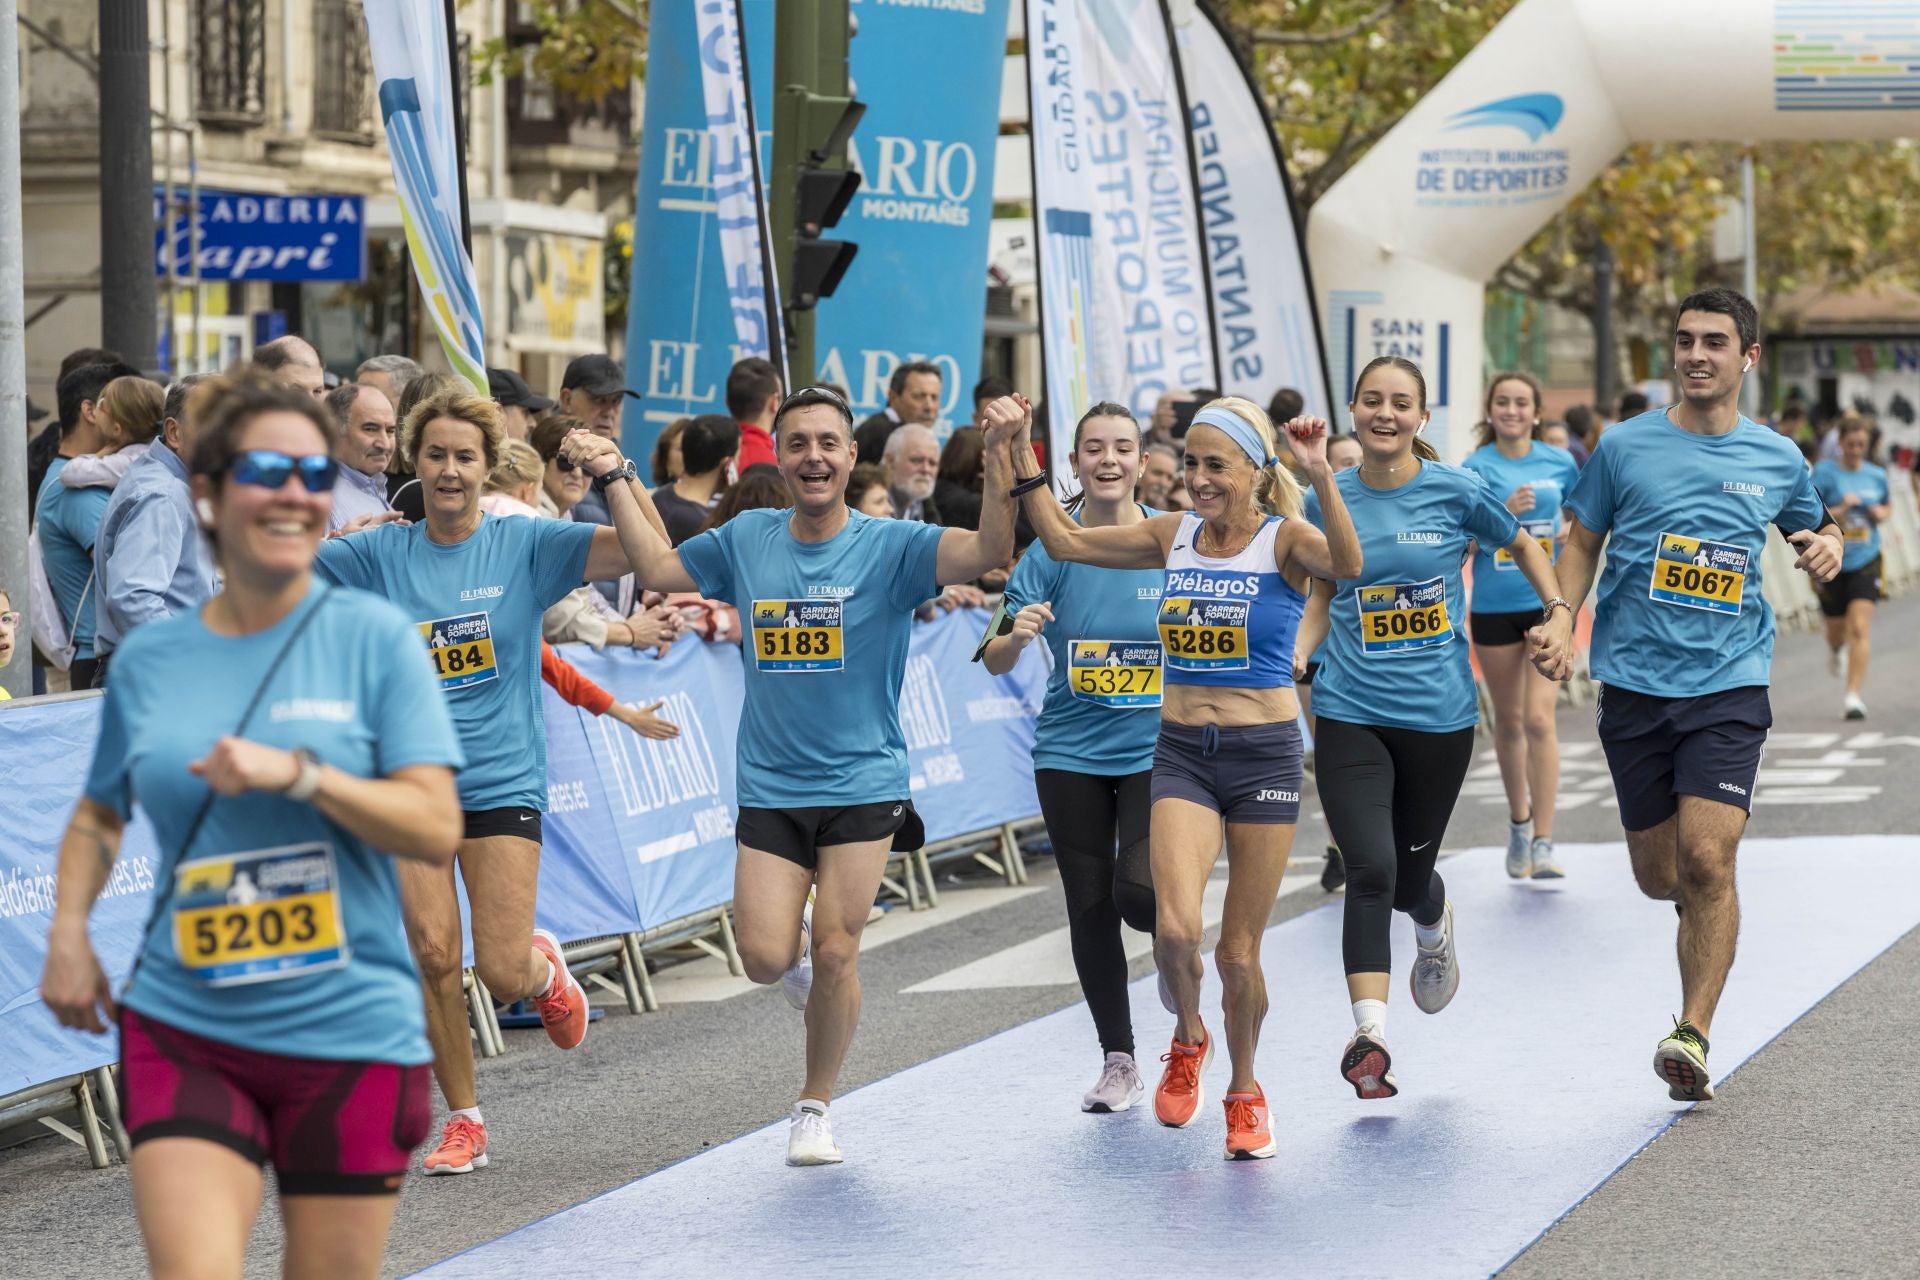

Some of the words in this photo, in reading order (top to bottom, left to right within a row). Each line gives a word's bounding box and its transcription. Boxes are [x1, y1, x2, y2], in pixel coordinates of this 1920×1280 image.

[1416, 168, 1445, 192] DE
[1453, 165, 1569, 192] DEPORTES
[1371, 320, 1423, 337] SAN
[1373, 341, 1423, 357] TAN
[646, 340, 716, 402] EL
[1723, 481, 1736, 491] EL
[1736, 482, 1765, 494] DIARIO
[1397, 533, 1410, 541] EL
[1411, 532, 1442, 541] DIARIO
[1670, 543, 1686, 554] 5K
[1713, 549, 1746, 561] CARRERA
[1711, 555, 1745, 566] POPULAR
[1665, 565, 1735, 597] 5067
[461, 590, 473, 599] EL
[474, 586, 503, 597] DIARIO
[808, 586, 820, 594] EL
[1138, 588, 1150, 597] EL
[1412, 583, 1443, 596] CARRERA
[1412, 589, 1443, 601] POPULAR
[1370, 594, 1385, 603] 5K
[761, 609, 776, 619] 5K
[801, 606, 840, 614] CARRERA
[1167, 606, 1180, 616] 5K
[1204, 611, 1245, 620] POPULAR
[1206, 605, 1246, 614] CARRERA
[800, 613, 839, 621] POPULAR
[1373, 608, 1441, 637] 5066
[447, 619, 487, 632] CARRERA
[447, 626, 487, 639] POPULAR
[763, 631, 830, 656] 5183
[1167, 629, 1236, 654] 5286
[433, 645, 484, 674] 184
[1083, 650, 1097, 660] 5K
[1080, 668, 1155, 694] 5327
[1256, 789, 1300, 802] Joma
[1719, 782, 1746, 796] adidas
[195, 903, 318, 956] 5203
